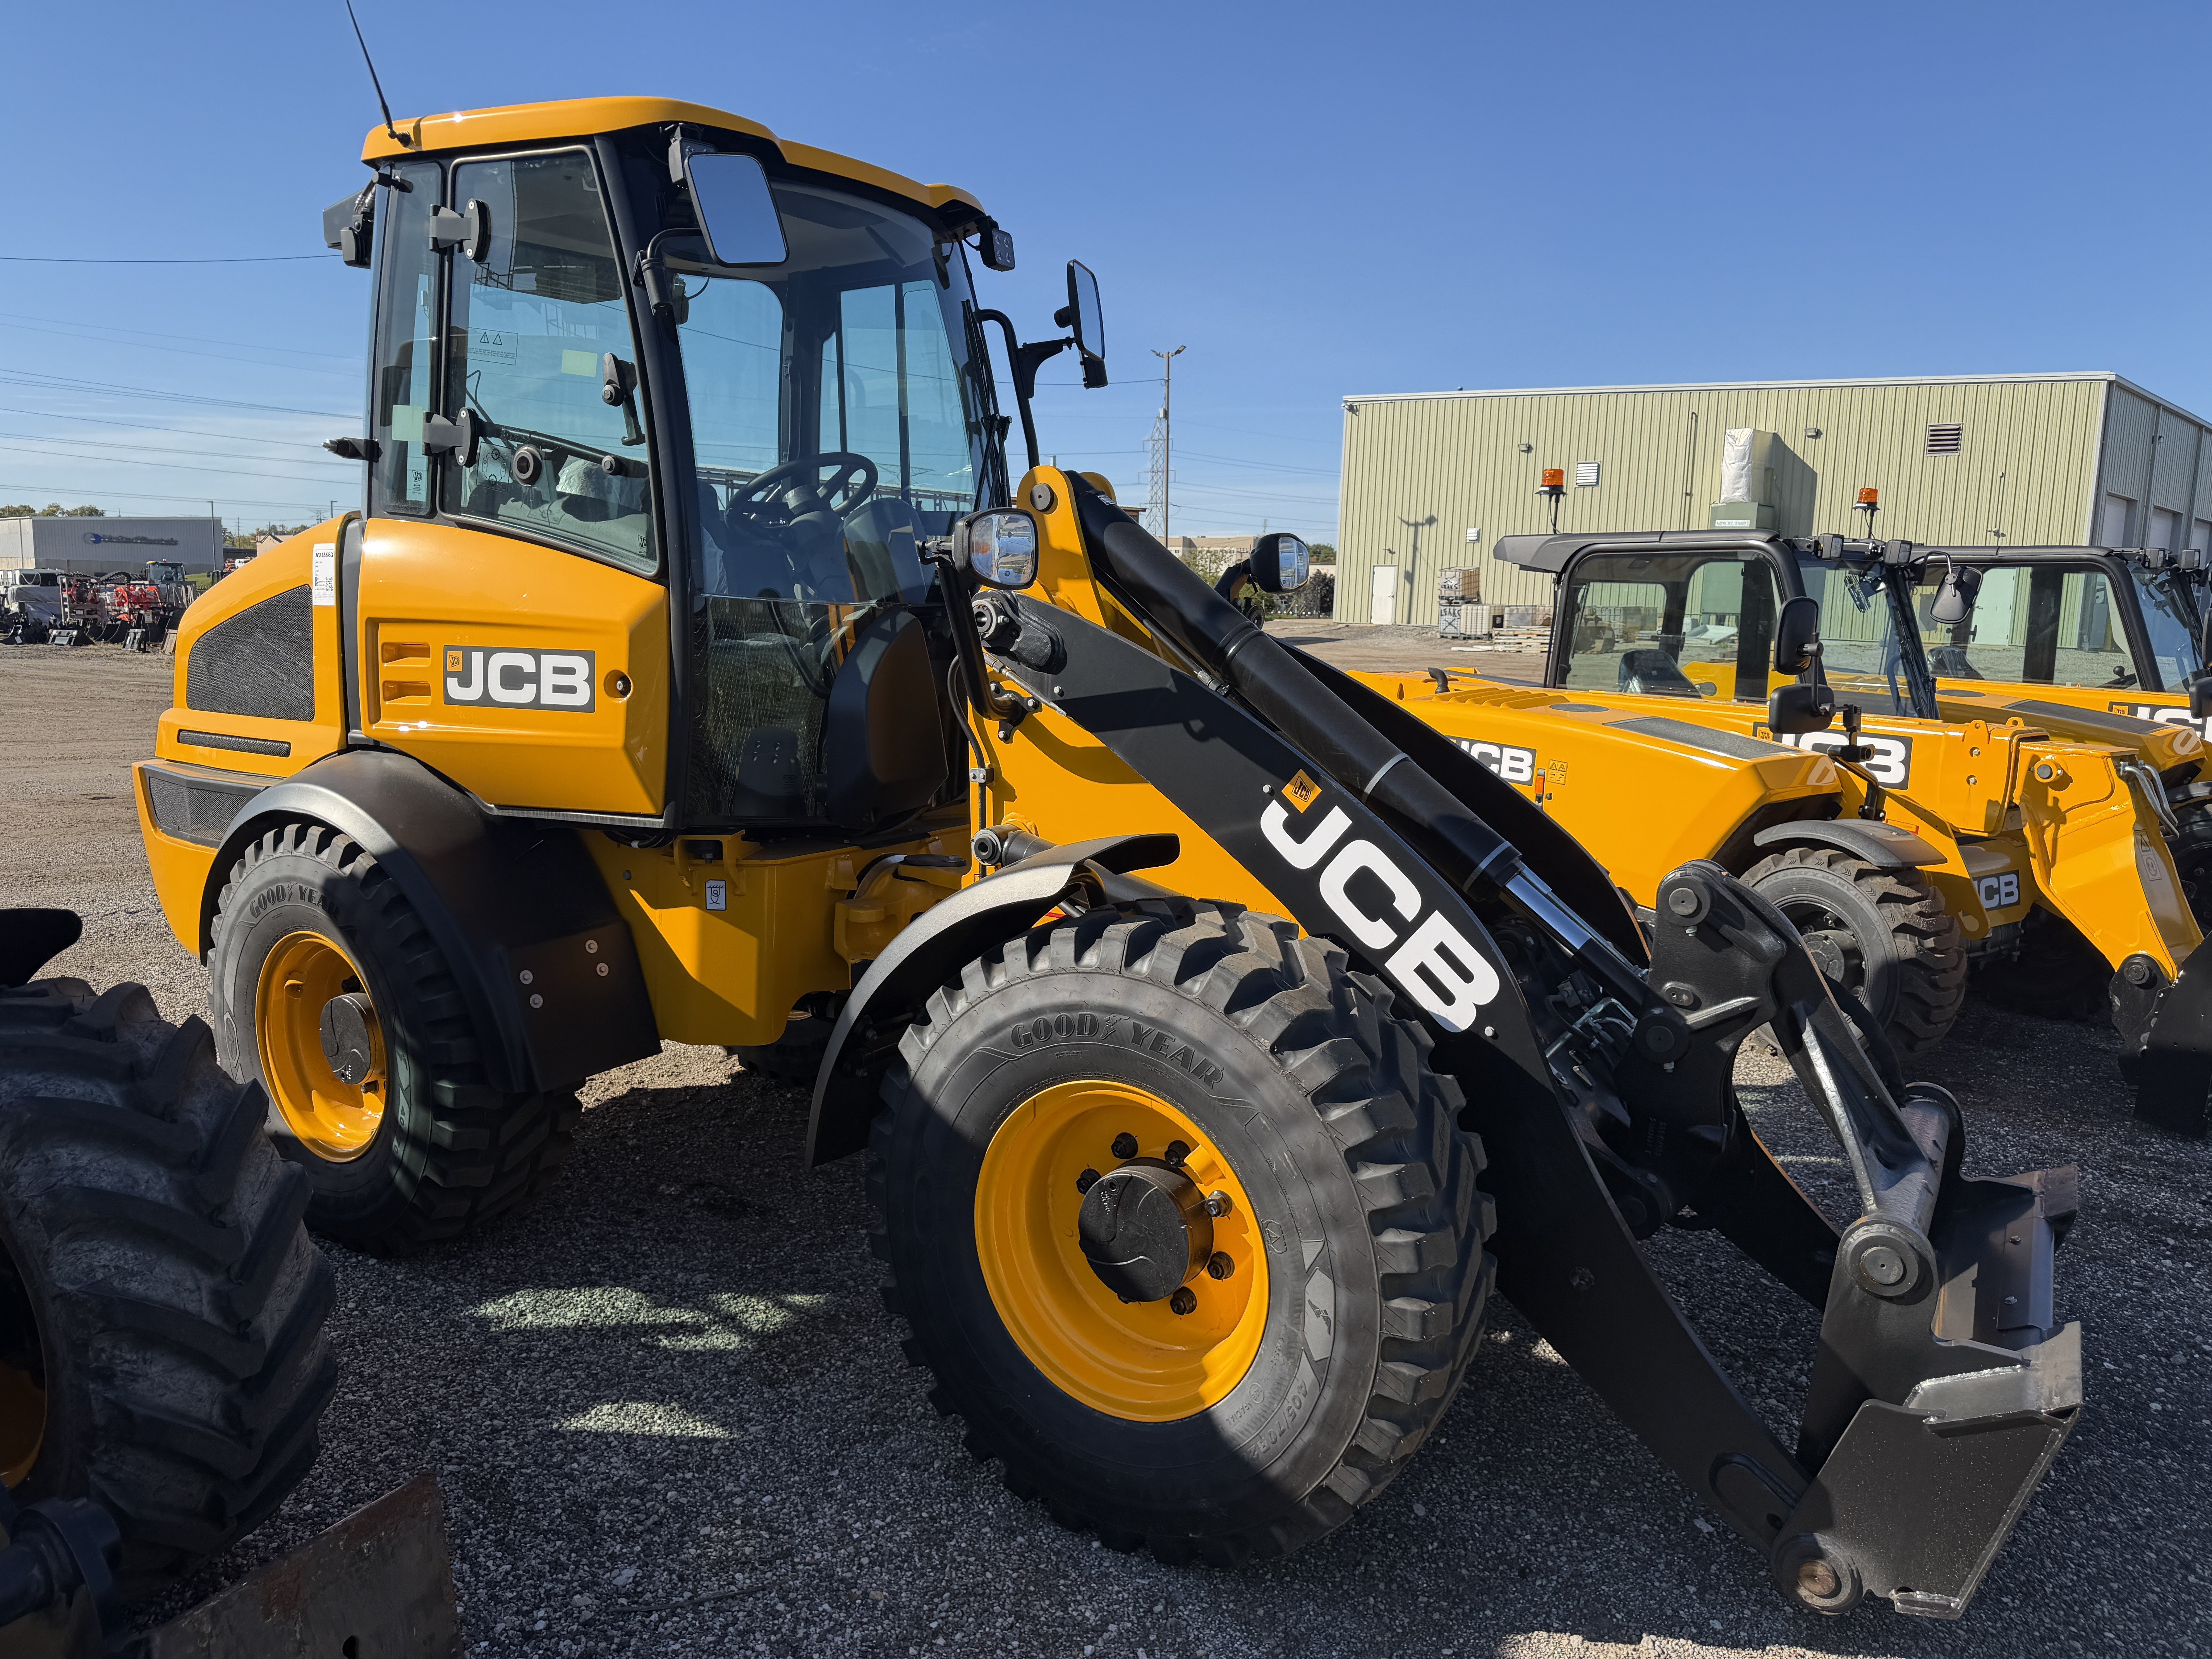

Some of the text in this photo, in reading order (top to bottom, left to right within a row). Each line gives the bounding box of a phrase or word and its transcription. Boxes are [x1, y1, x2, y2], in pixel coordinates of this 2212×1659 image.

[447, 652, 590, 706] JCB
[450, 656, 460, 666] JCB
[1461, 740, 1533, 782] CB
[1293, 780, 1310, 801] JCB
[1973, 874, 2019, 908] CB
[1260, 799, 1500, 1033] JCB
[1011, 1012, 1225, 1090] GOOD YEAR
